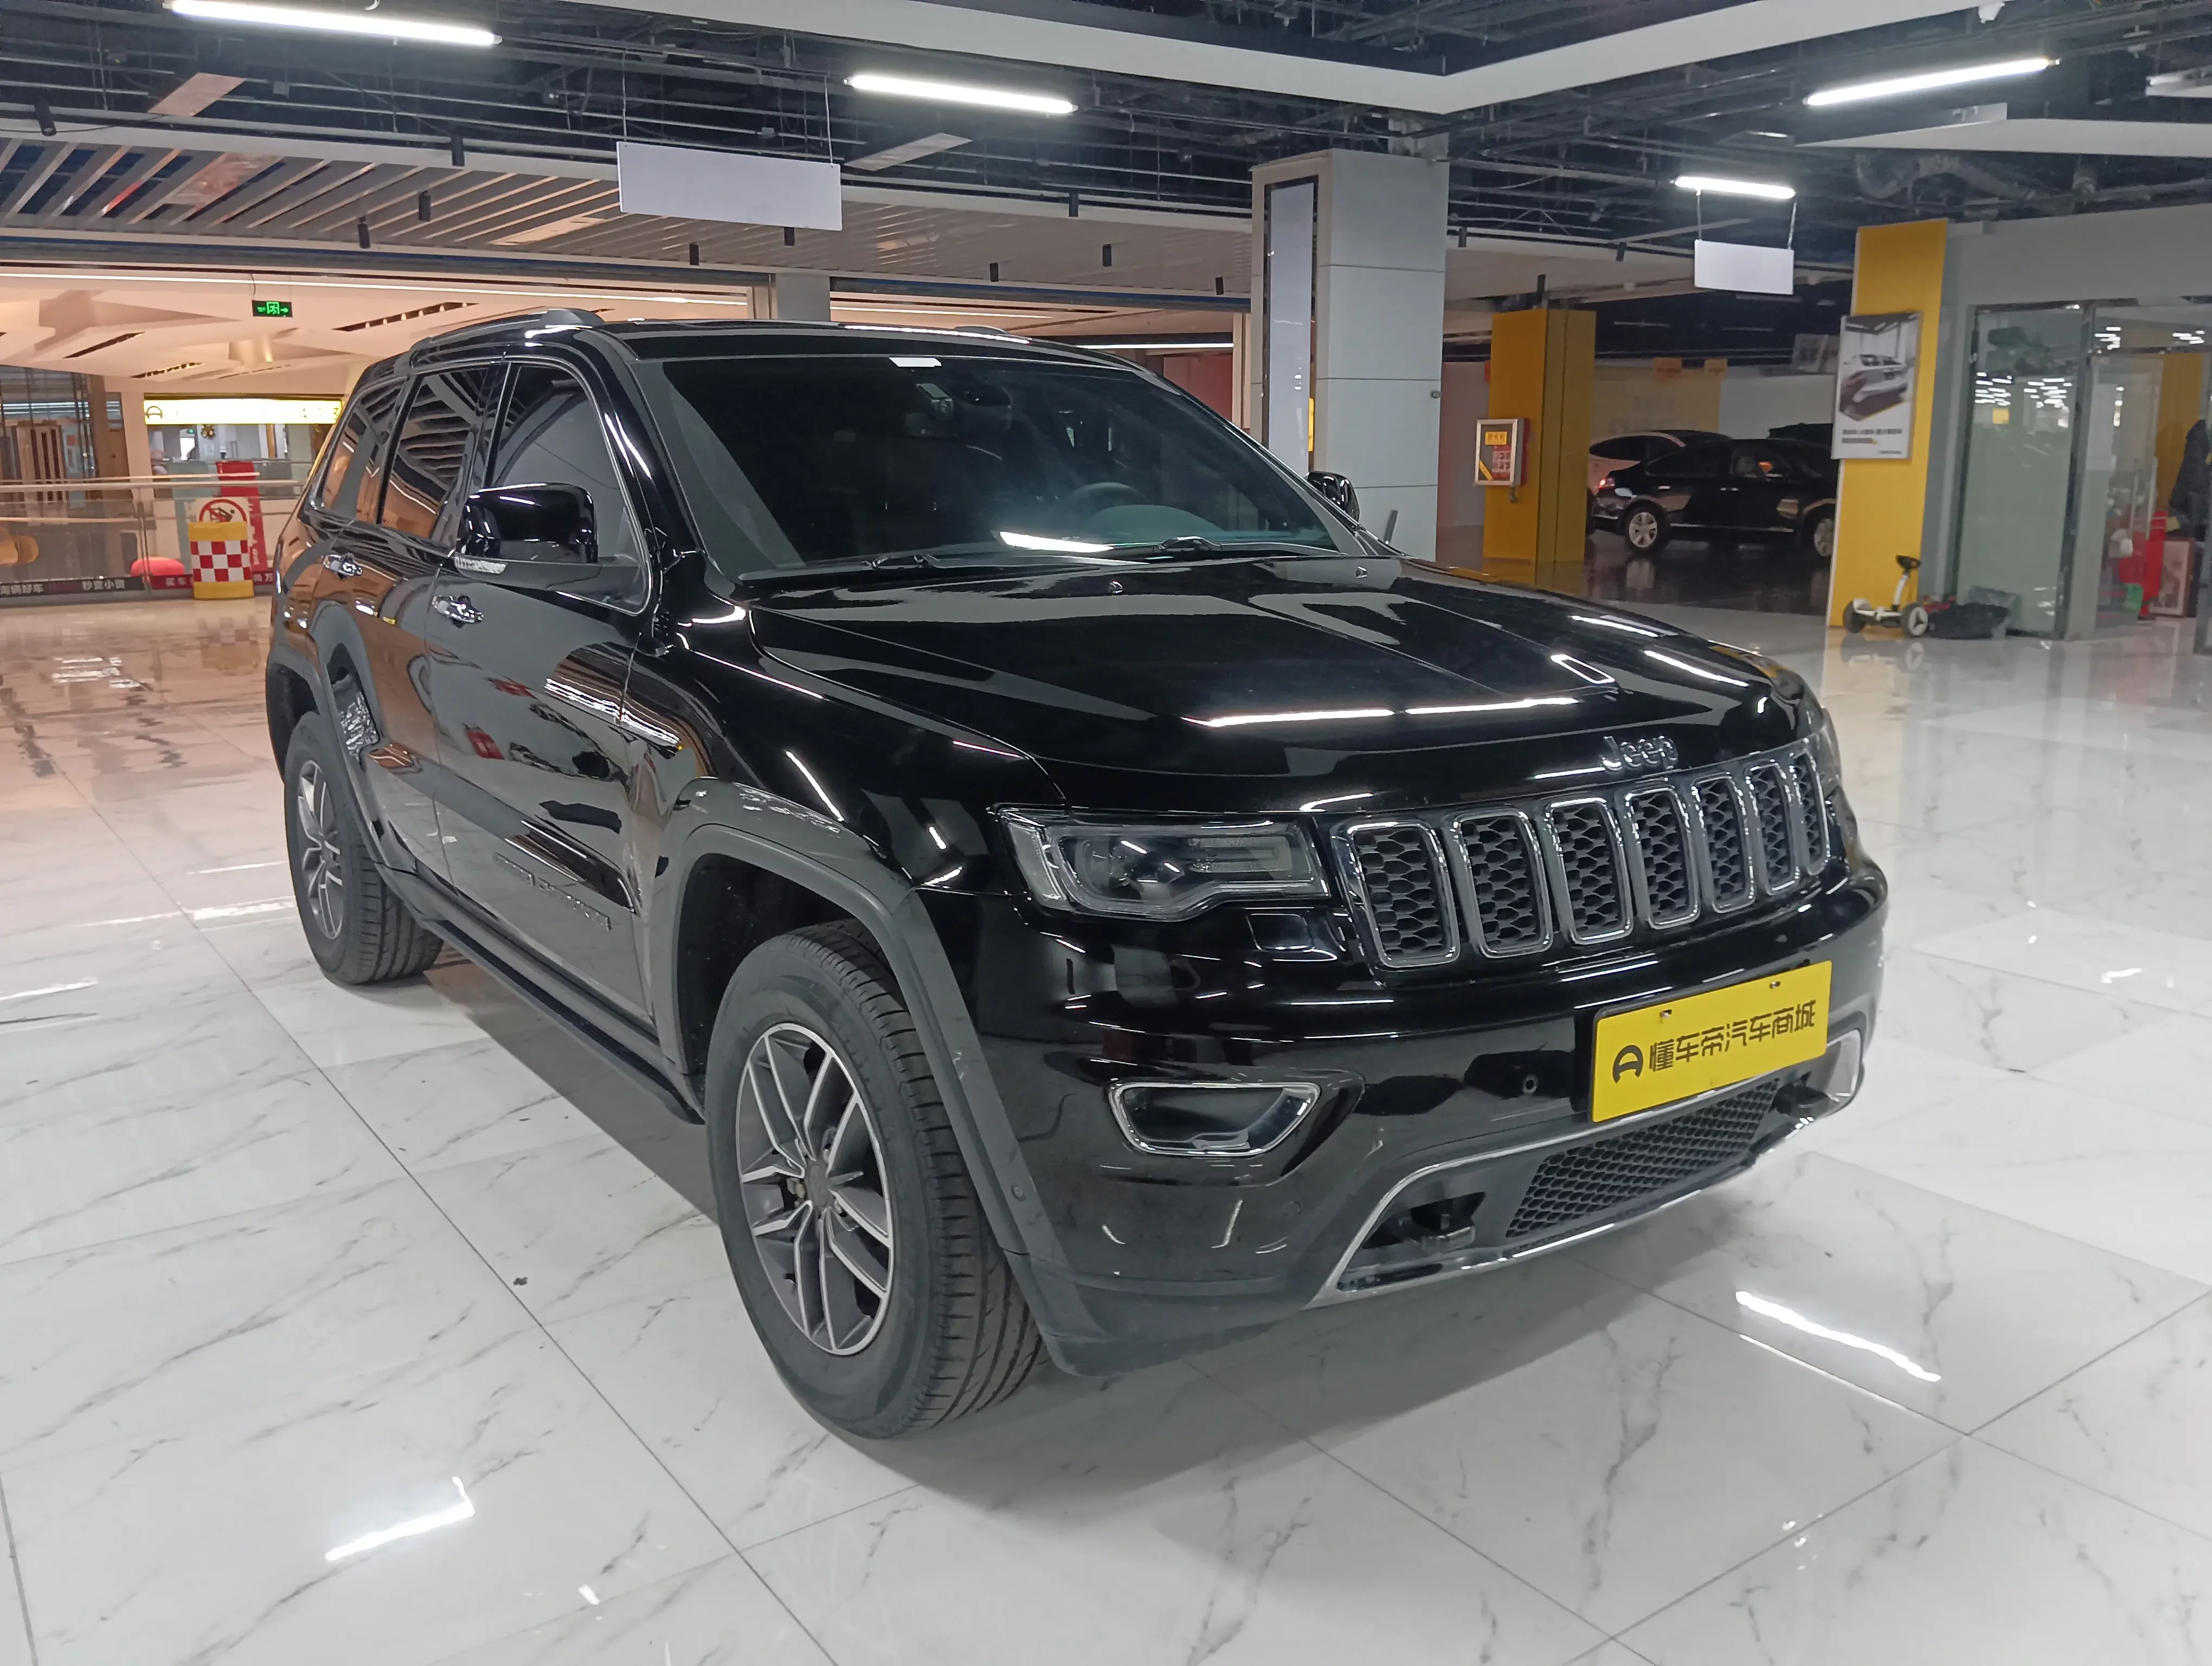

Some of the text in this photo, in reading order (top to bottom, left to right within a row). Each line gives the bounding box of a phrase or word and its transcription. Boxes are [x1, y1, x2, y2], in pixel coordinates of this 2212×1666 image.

[1601, 735, 1679, 771] Jeep
[1649, 998, 1817, 1072] 懂车帝汽车商城
